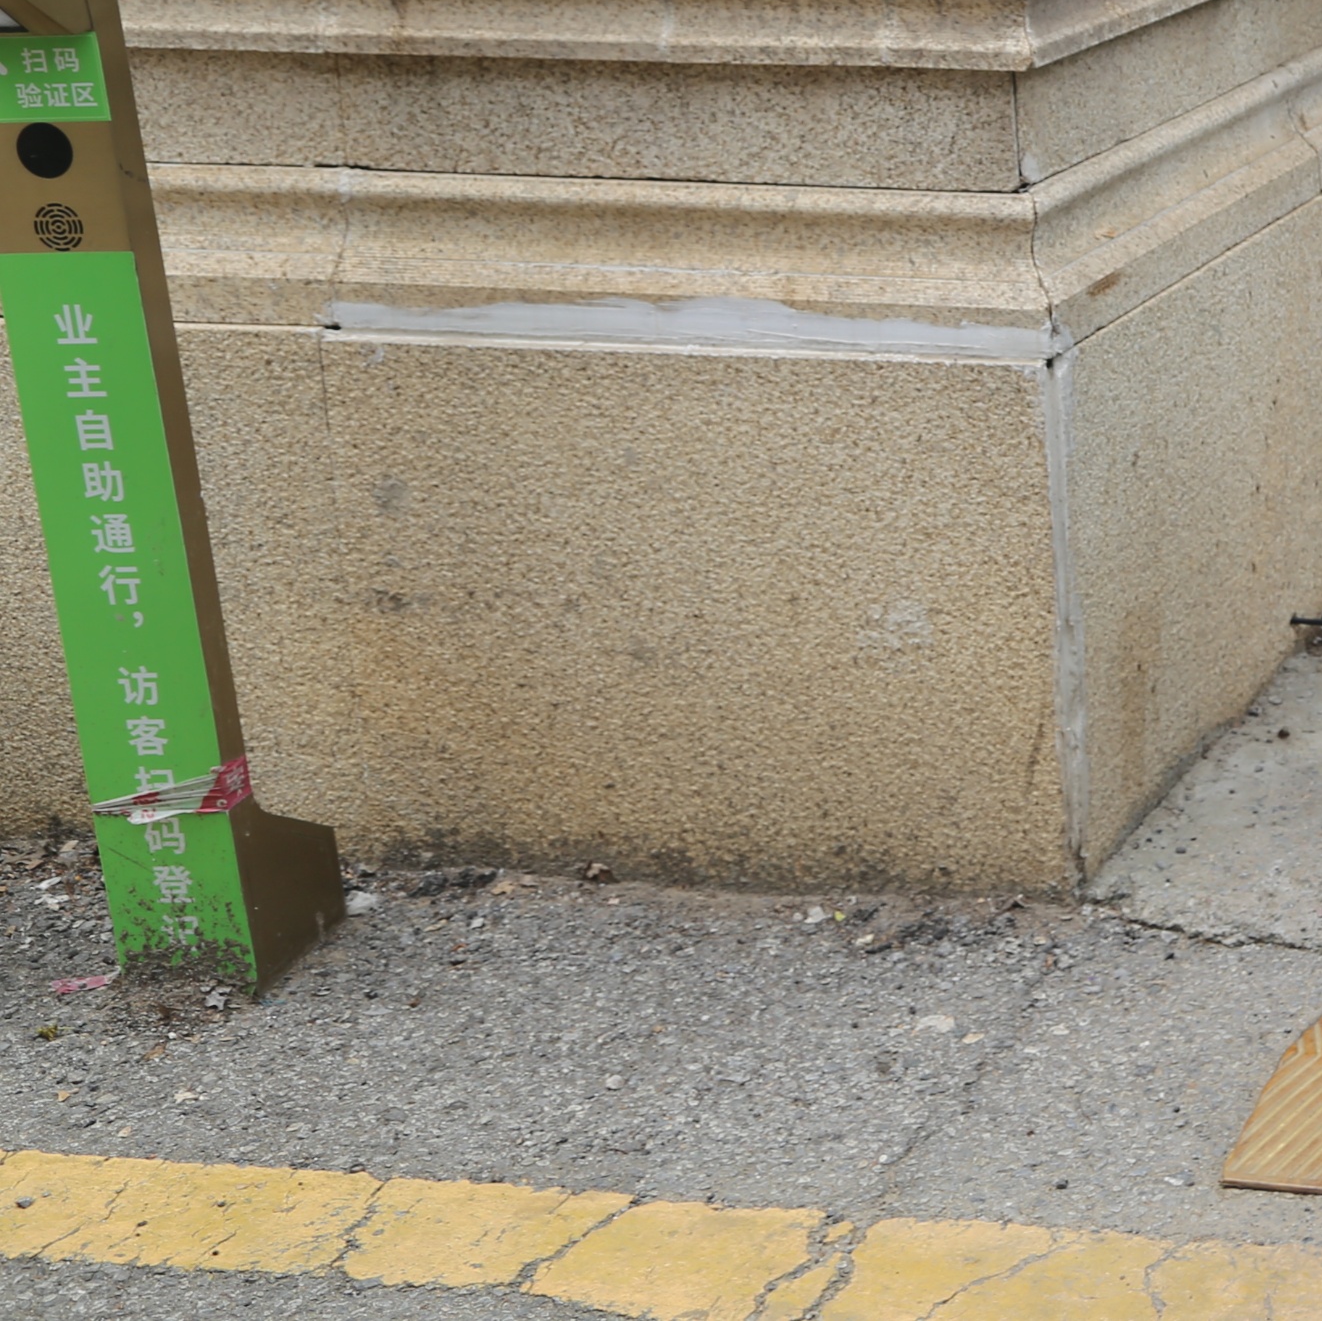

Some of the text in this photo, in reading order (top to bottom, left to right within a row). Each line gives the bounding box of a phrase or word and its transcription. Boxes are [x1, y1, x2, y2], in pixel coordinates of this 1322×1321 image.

[21, 48, 79, 73] 扫码
[15, 82, 98, 108] 验证区
